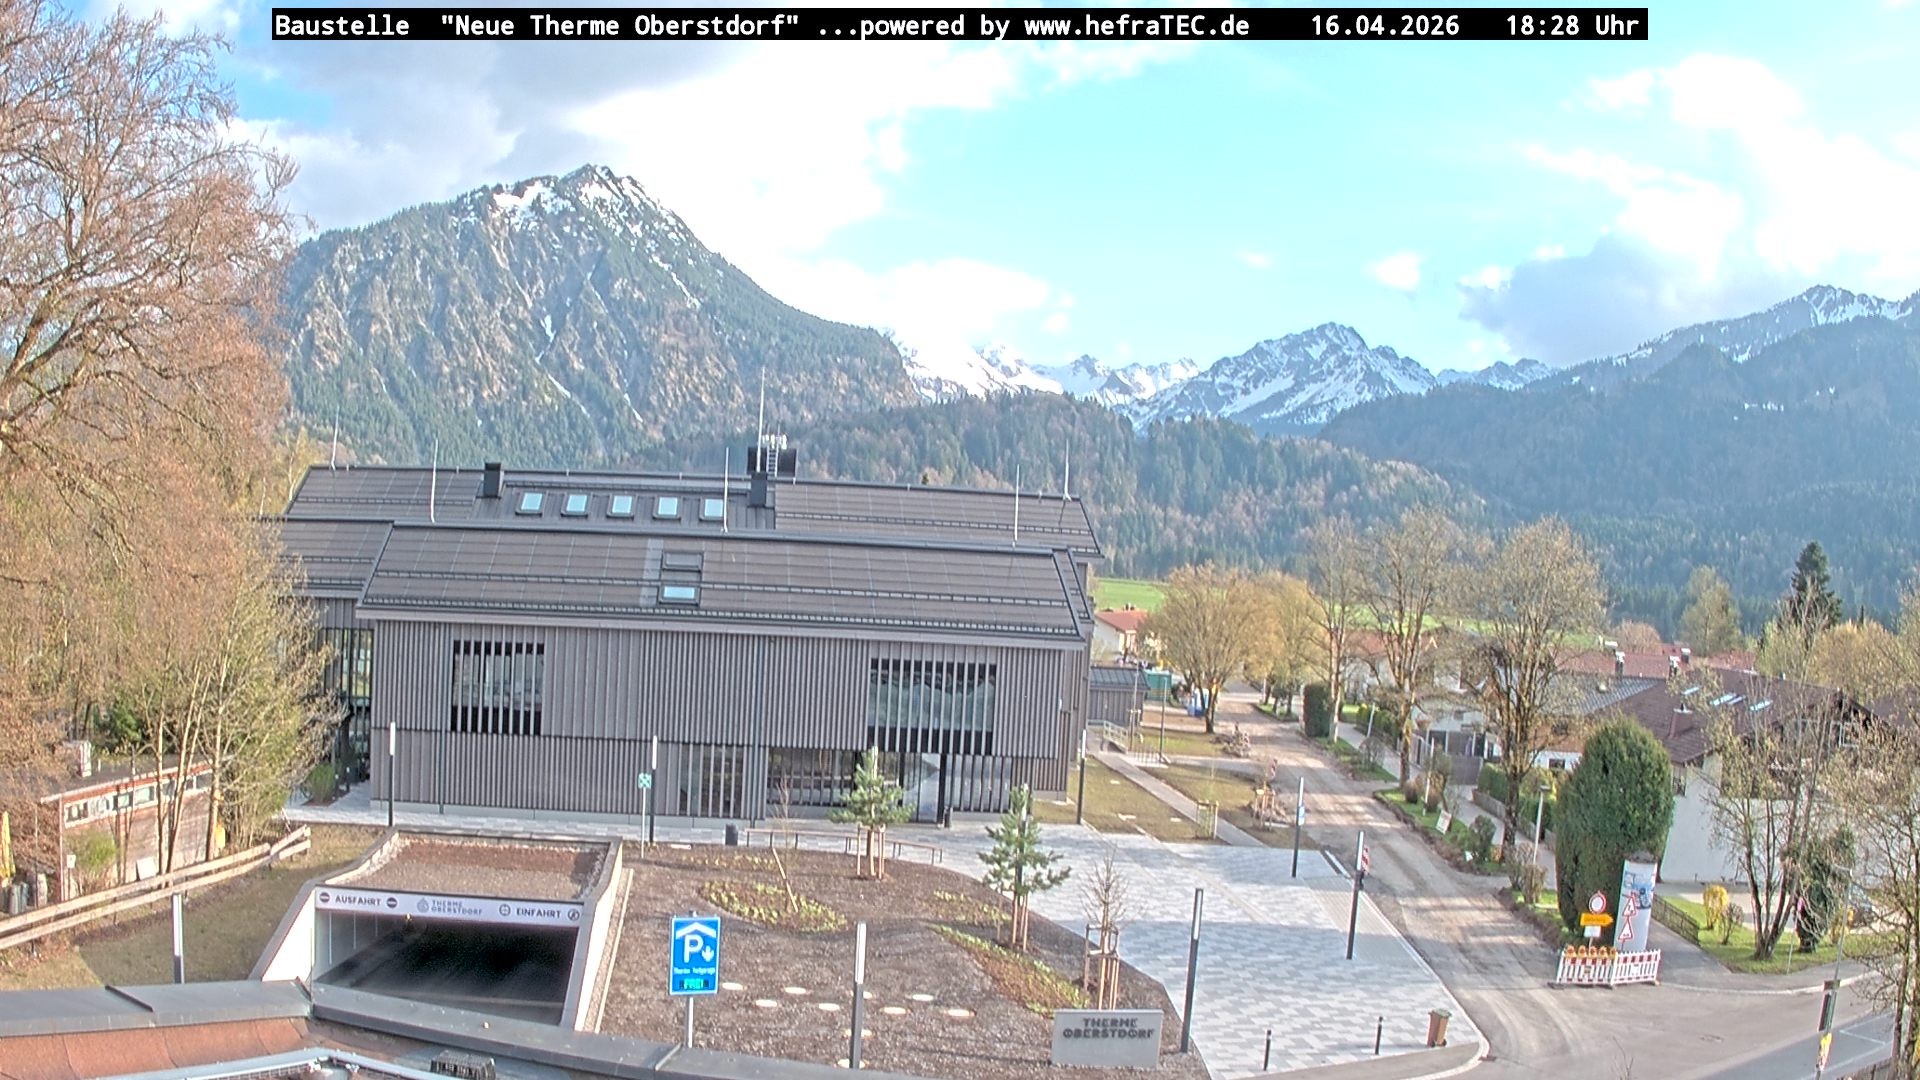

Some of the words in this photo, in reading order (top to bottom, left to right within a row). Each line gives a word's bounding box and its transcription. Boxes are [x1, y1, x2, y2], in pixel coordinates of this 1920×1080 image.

[335, 895, 382, 906] AUSFAHRT
[516, 908, 561, 919] EINFAHRT
[684, 934, 703, 963] P
[1083, 1018, 1138, 1027] THERME
[1063, 1028, 1154, 1038] OBERSTDORF
